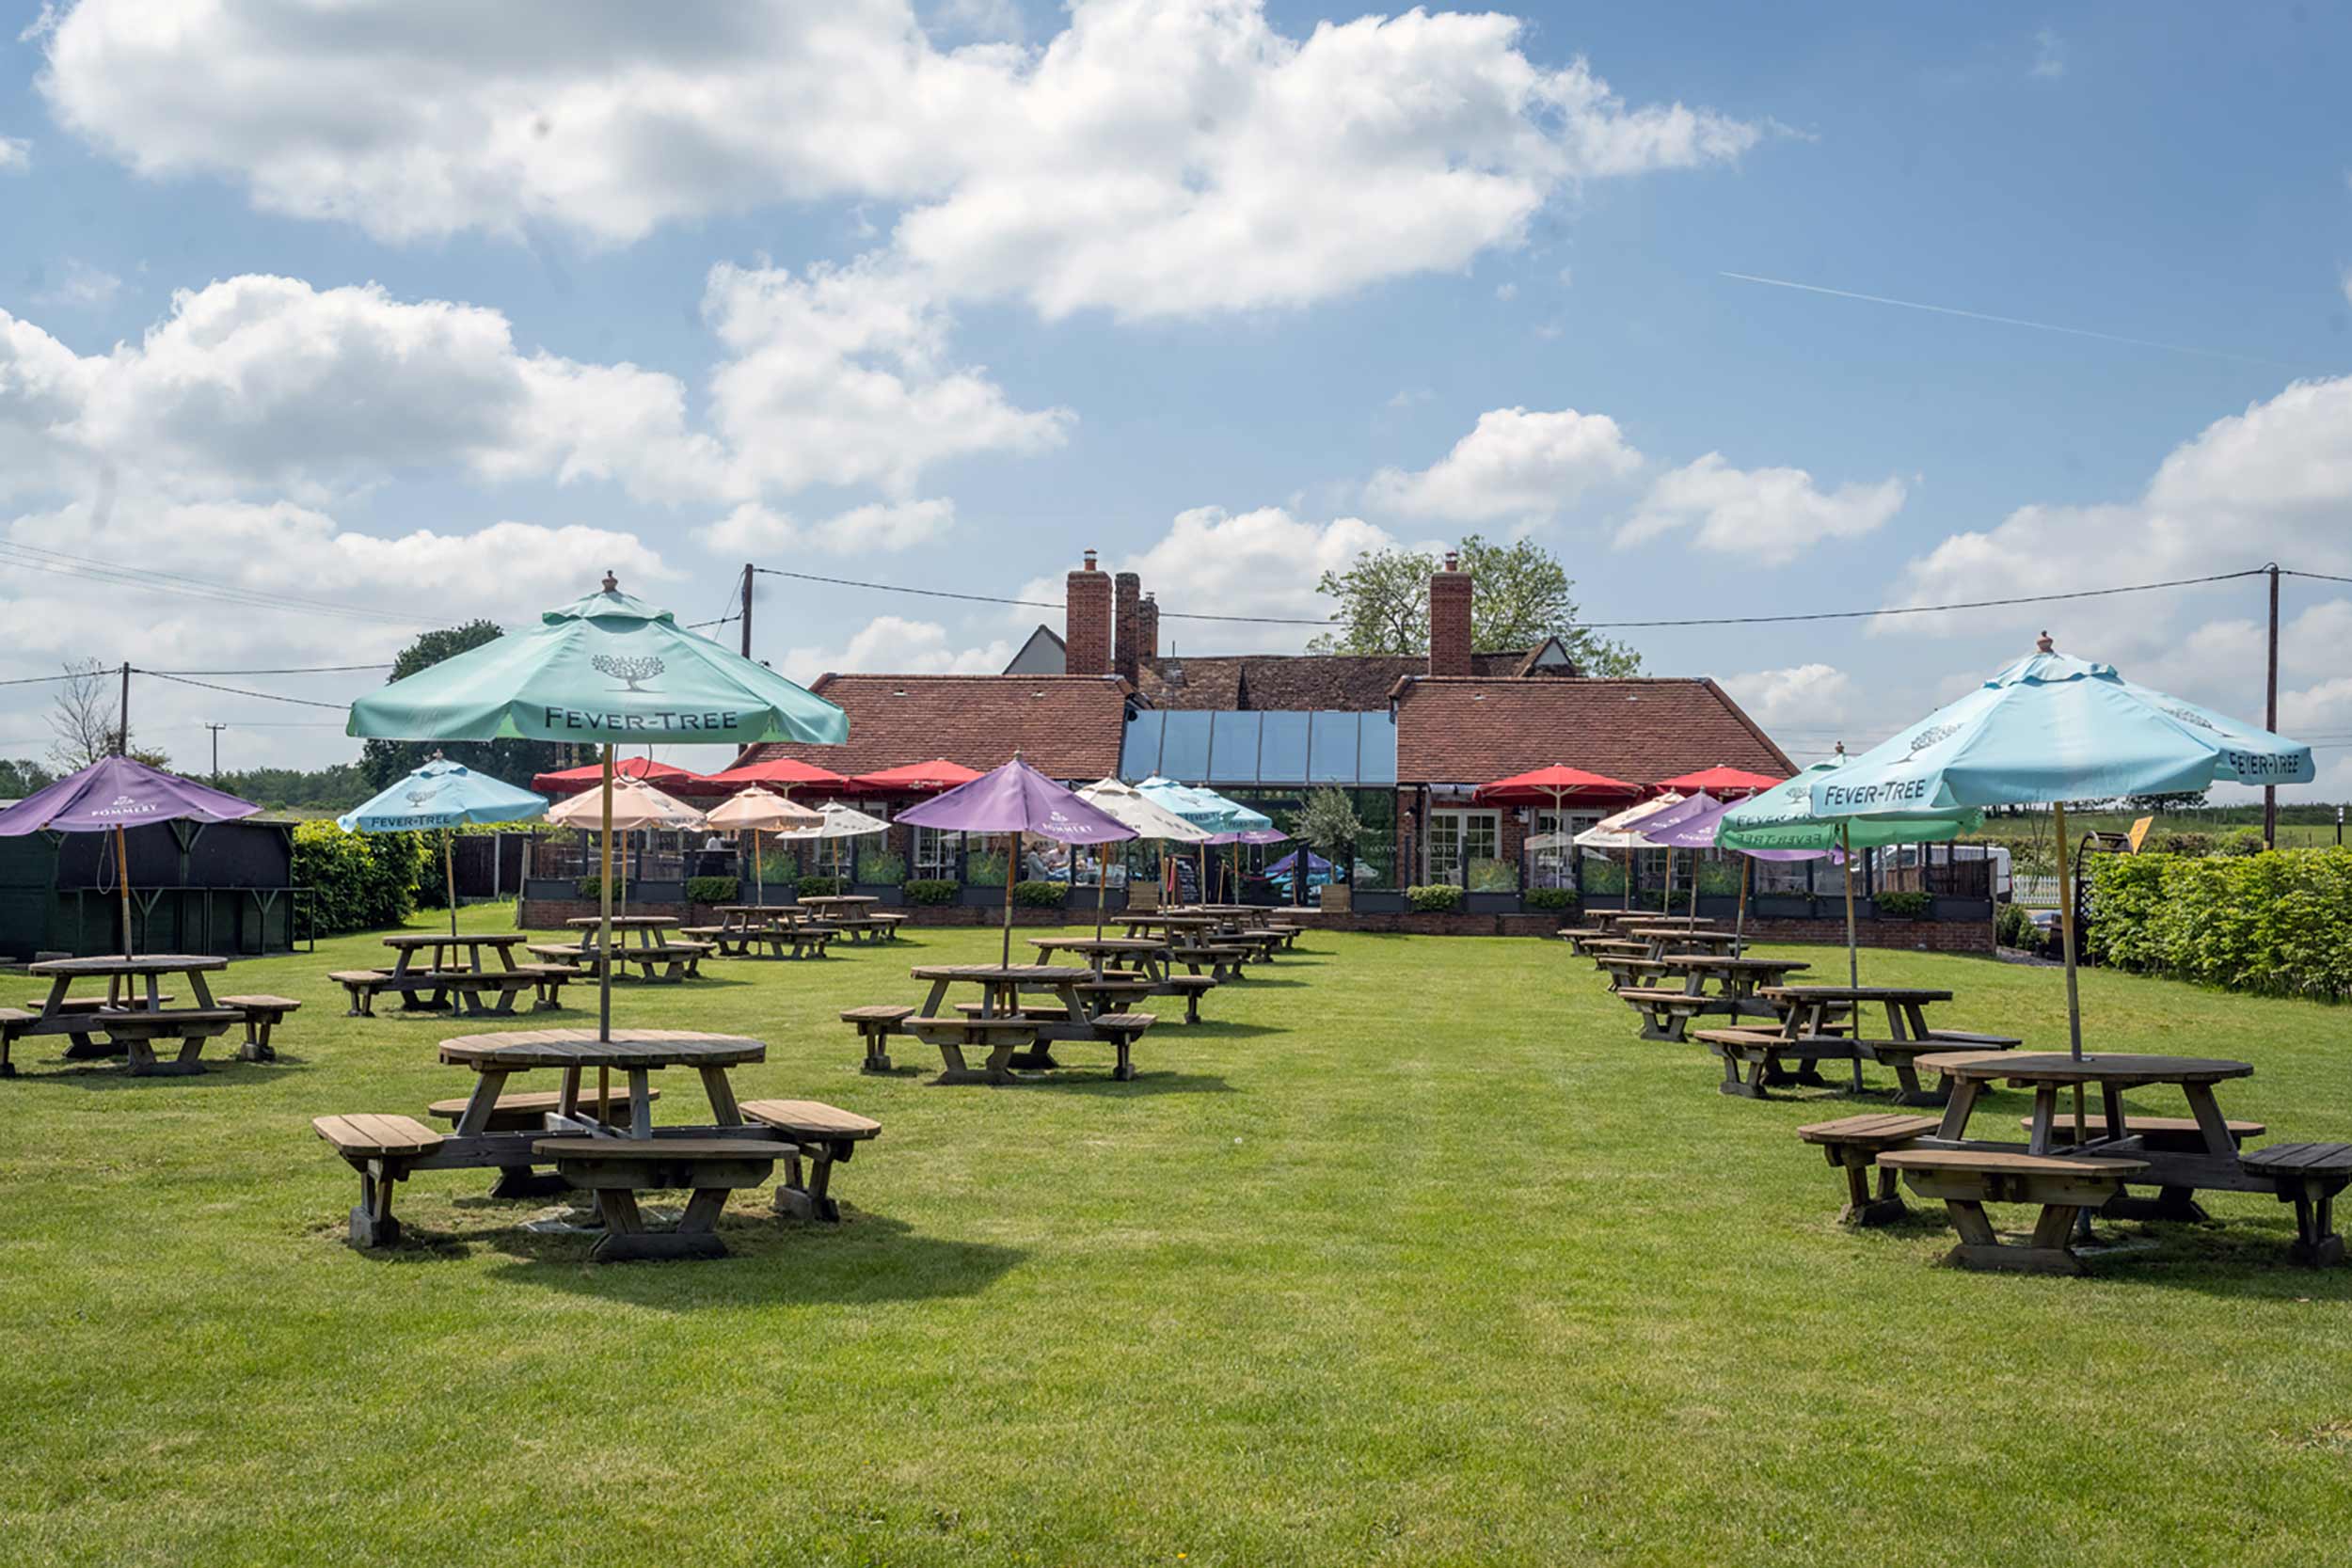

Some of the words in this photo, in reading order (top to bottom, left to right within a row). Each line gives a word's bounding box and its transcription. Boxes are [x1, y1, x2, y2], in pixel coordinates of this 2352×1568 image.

[545, 706, 738, 730] FEVER-TREE
[1825, 779, 1925, 806] FEVER-TREE
[371, 814, 451, 827] FEVER-TREE
